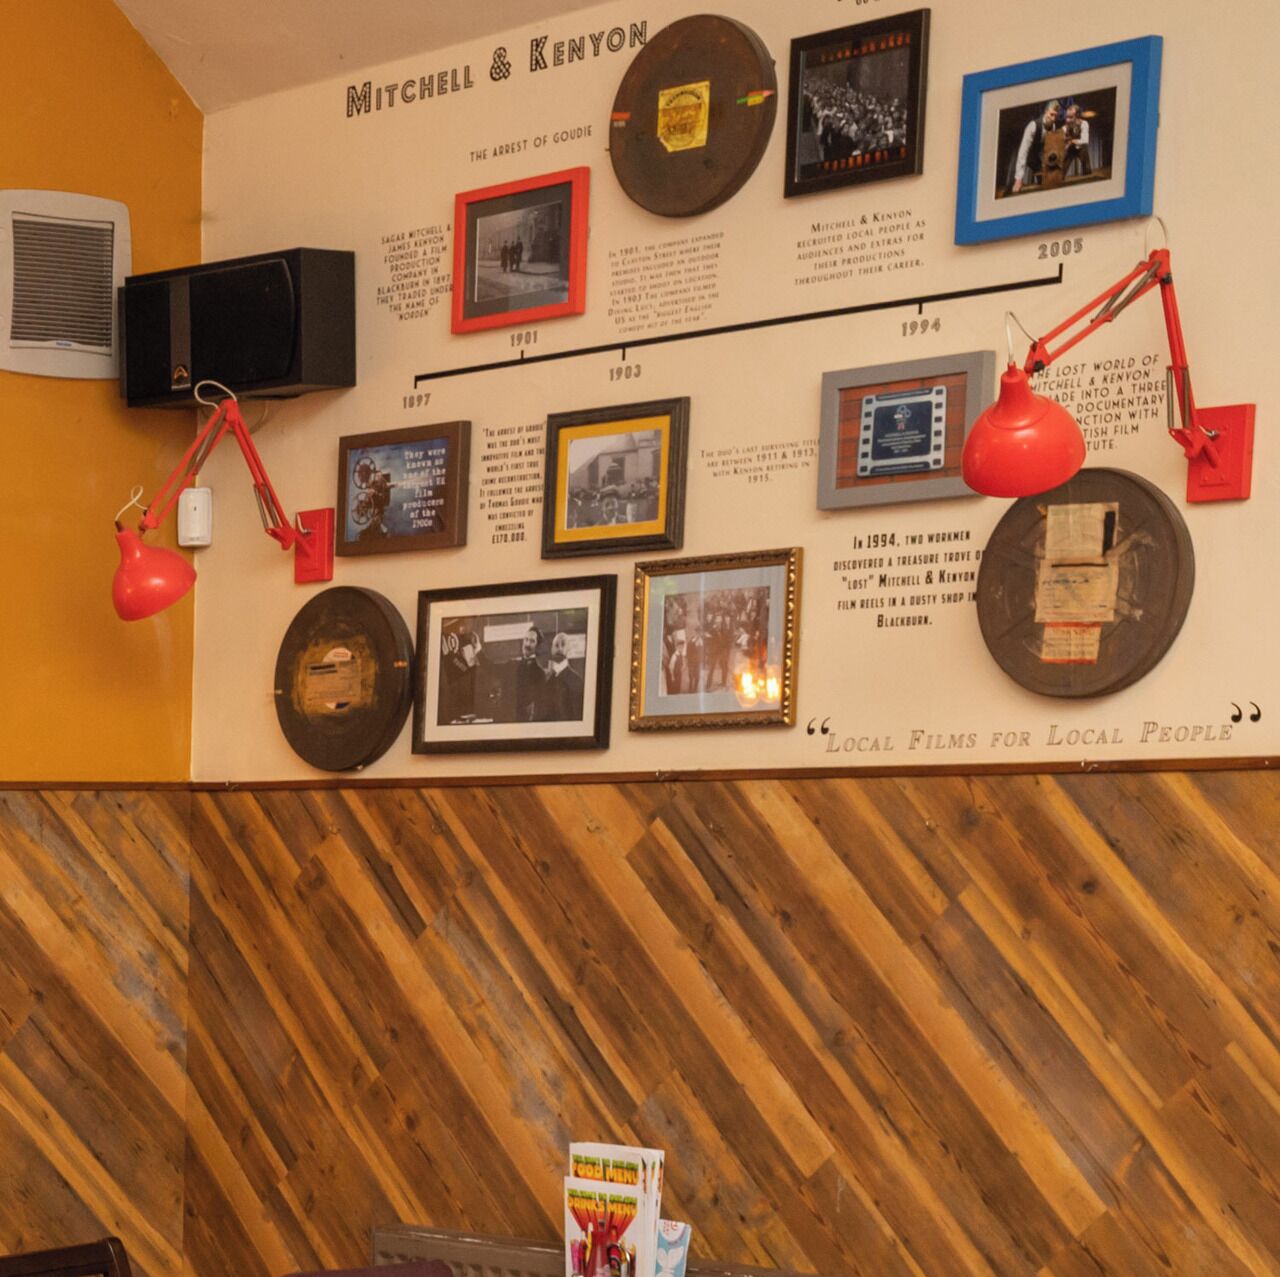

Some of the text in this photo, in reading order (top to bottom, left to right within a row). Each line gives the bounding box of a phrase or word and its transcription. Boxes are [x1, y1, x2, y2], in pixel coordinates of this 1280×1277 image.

[346, 21, 647, 117] MITCHELL & KENYON
[470, 125, 592, 162] THE ARREST OF GOUDIE
[811, 208, 912, 233] MITCHELL & KENYON
[409, 225, 442, 238] MITCHELL
[797, 219, 926, 248] RECRUITED LOCAL PEOPLE AS
[389, 235, 443, 253] JAMES KENYON
[797, 233, 924, 260] AUDIENCES AND EXTRAS FOR
[1038, 238, 1083, 260] 2005
[384, 250, 418, 263] FOUNDED
[431, 246, 447, 254] FILM
[814, 249, 905, 270] THEIR PRODUCTIONS
[391, 256, 440, 272] PRODUCTION
[392, 269, 427, 282] COMPANY
[795, 270, 853, 286] THROUGHOUT
[859, 265, 882, 276] THEIR
[377, 295, 393, 304] THEY
[399, 289, 427, 300] TRADED
[378, 281, 419, 295] BLACKBURN
[389, 297, 438, 312] THE NAME OF
[901, 318, 941, 336] 1994
[510, 331, 538, 347] 1901
[609, 365, 641, 381] 1903
[1056, 354, 1159, 377] LOST WORLD OF
[1089, 377, 1095, 386] &
[1049, 380, 1166, 402] ADE INTO A THREE
[403, 393, 431, 409] 1897
[1077, 394, 1165, 413] DOCUMENTARY
[1128, 408, 1158, 419] WITH
[1083, 424, 1139, 438] TISH FILM
[756, 452, 777, 462] 1911
[867, 533, 900, 549] 1994,
[906, 535, 923, 545] TWO
[928, 531, 970, 543] WORKMEN
[834, 558, 883, 571] DISCOVERED
[888, 558, 892, 566] A
[897, 553, 939, 566] TREASURE
[944, 550, 970, 562] TROVE
[879, 574, 920, 587] MITCHELL
[925, 570, 933, 584] &
[939, 570, 975, 583] KENYON
[838, 600, 856, 610] FILM
[860, 598, 884, 609] REELS
[888, 597, 896, 606] IN
[901, 597, 906, 606] A
[910, 595, 937, 606] DUSTY
[942, 593, 964, 603] SHOP
[877, 614, 933, 627] BLACKBURN.
[909, 729, 977, 750] FILMS
[990, 731, 1031, 749] FOR
[1047, 724, 1123, 746] LOCAL
[572, 1164, 639, 1185] FOOD MENU
[568, 1198, 638, 1215] DRINKS MENU
